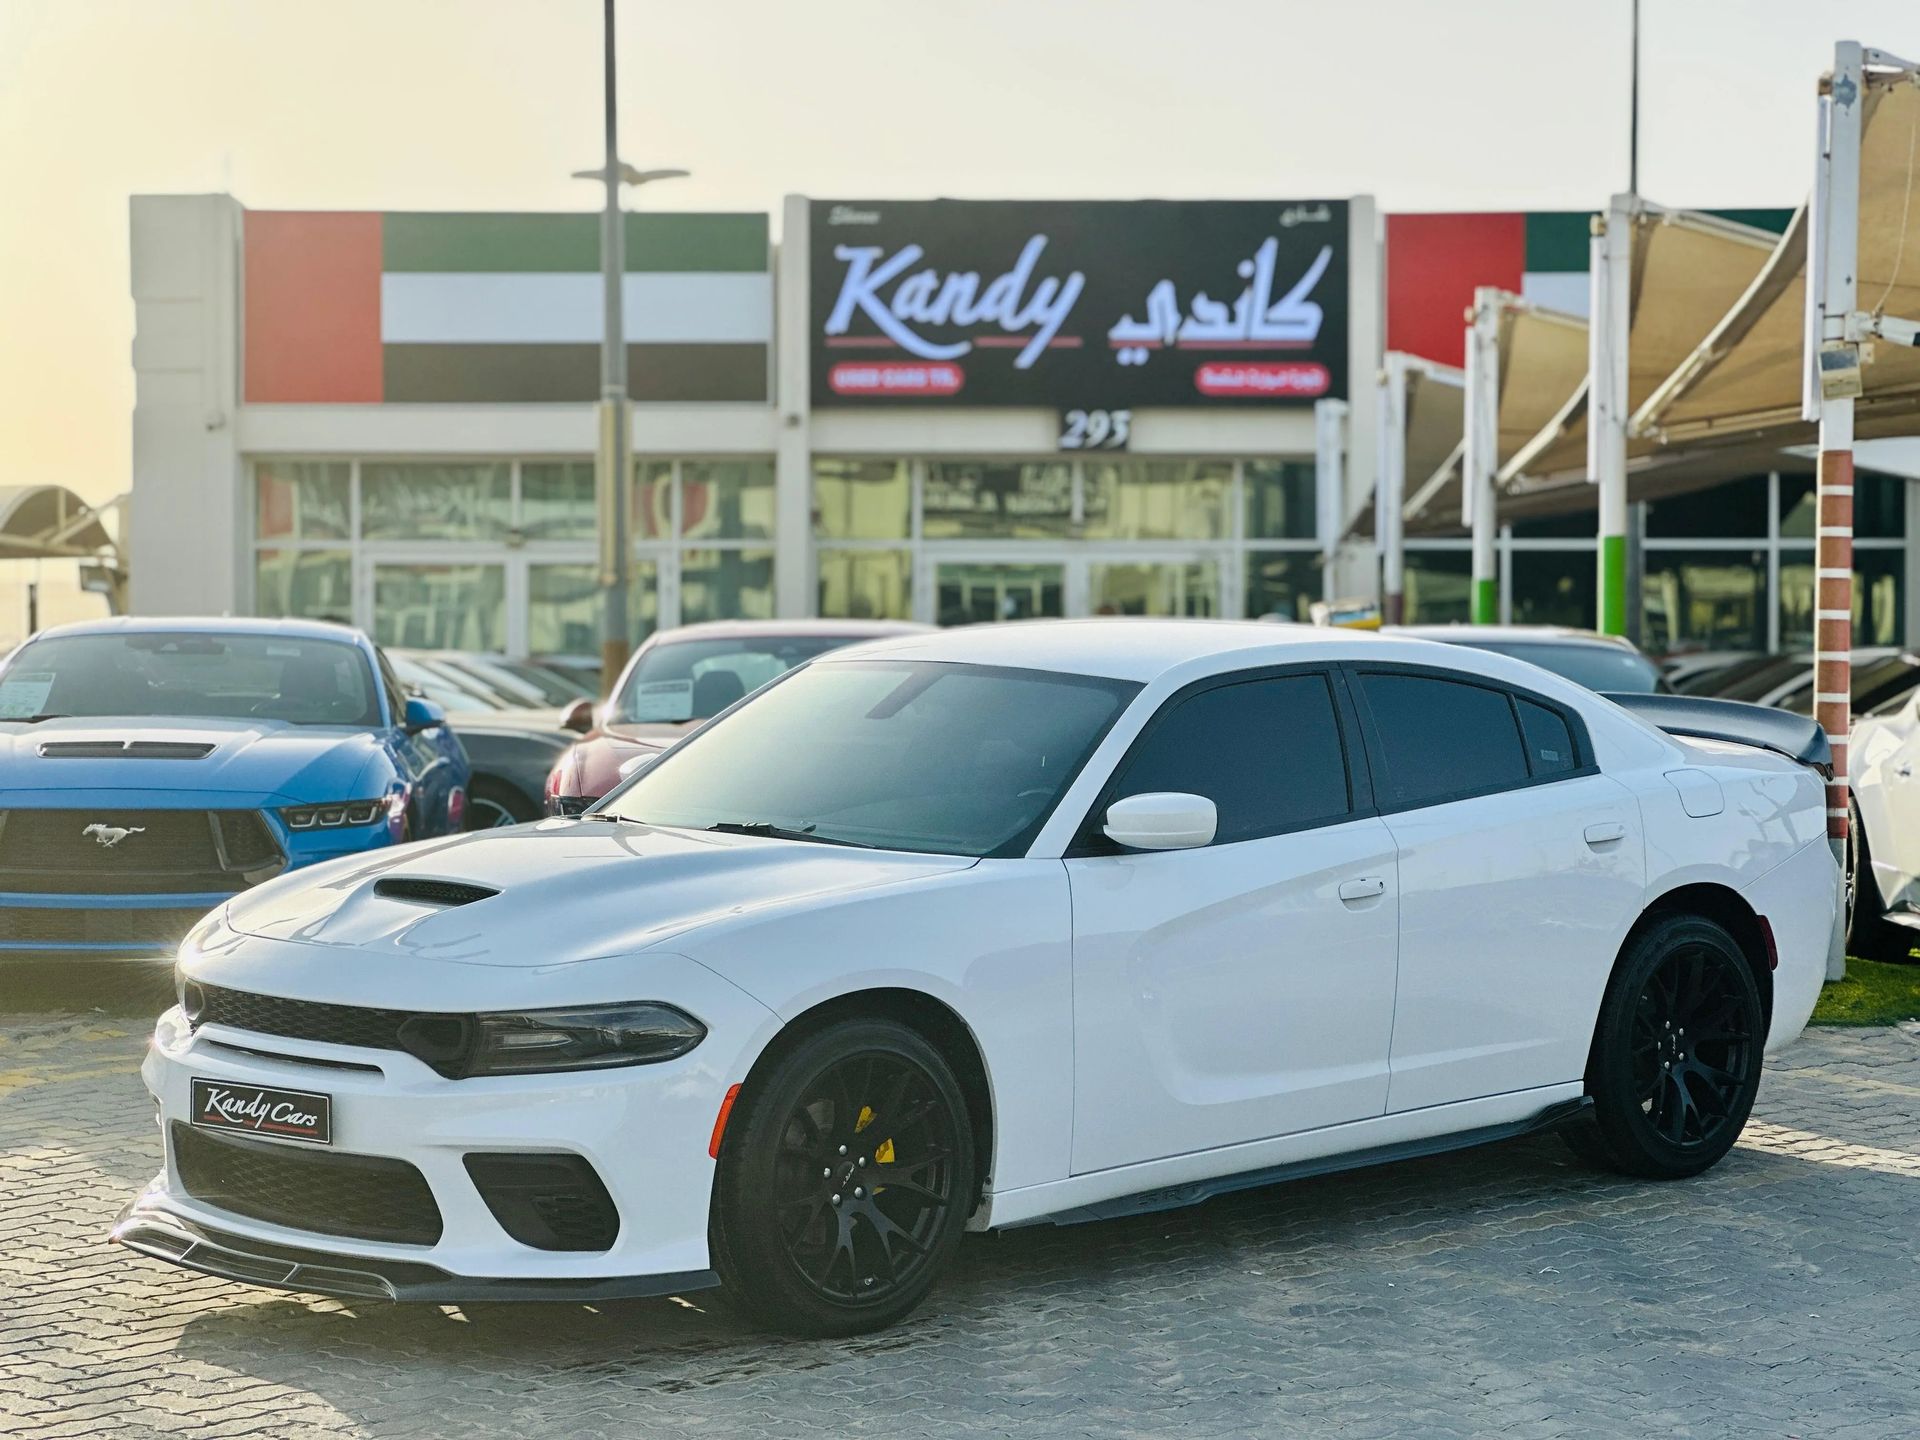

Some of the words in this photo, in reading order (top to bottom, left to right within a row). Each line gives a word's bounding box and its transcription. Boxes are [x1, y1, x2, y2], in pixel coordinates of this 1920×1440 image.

[825, 234, 1085, 369] Kandy
[1109, 236, 1331, 366] كاندي
[1058, 409, 1132, 448] 295
[204, 1087, 271, 1129] Kandy
[270, 1102, 318, 1127] Cars
